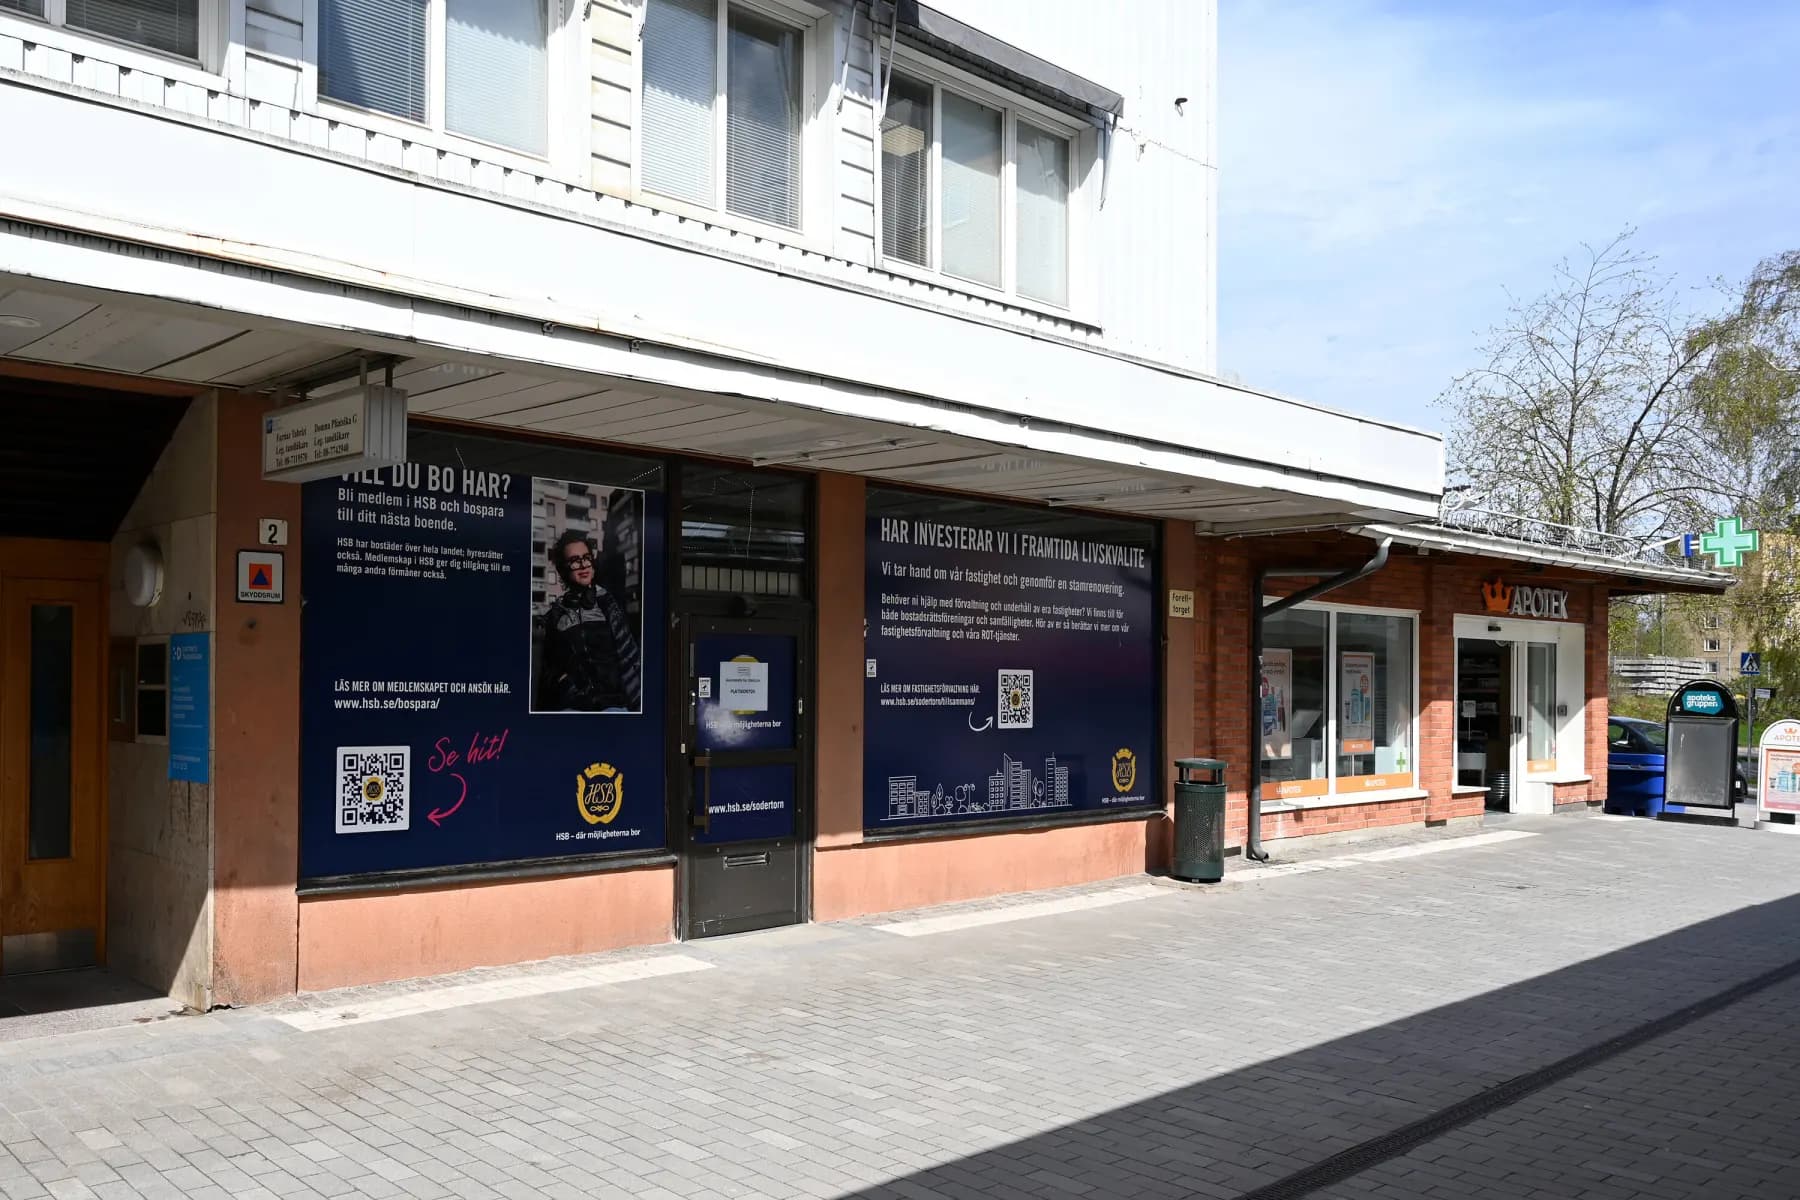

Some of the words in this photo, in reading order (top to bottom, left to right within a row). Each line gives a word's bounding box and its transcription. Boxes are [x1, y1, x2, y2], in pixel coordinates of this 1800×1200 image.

[392, 462, 420, 489] DU
[428, 465, 455, 493] BO
[337, 488, 354, 502] Bli
[357, 491, 403, 507] medlem
[406, 494, 410, 508] i
[414, 496, 437, 511] HSB
[440, 499, 460, 513] och
[463, 501, 504, 519] bospara
[337, 507, 354, 522] till
[357, 510, 377, 524] ditt
[380, 512, 411, 527] nästa
[414, 514, 457, 531] boende.
[267, 523, 278, 544] 2
[914, 520, 993, 553] INVESTERAR
[997, 531, 1009, 554] VI
[1013, 533, 1017, 555] I
[1021, 534, 1079, 562] FRAMTIDA
[337, 537, 354, 547] HSB
[355, 538, 369, 549] har
[370, 539, 403, 551] bostäder
[405, 543, 421, 553] över
[423, 544, 439, 554] hela
[466, 548, 503, 560] hyresrätter
[337, 550, 362, 562] också.
[365, 552, 412, 566] Medlemskap
[419, 556, 434, 566] HSB
[436, 558, 448, 569] ger
[450, 558, 461, 569] dig
[462, 559, 489, 571] tillgång
[491, 561, 501, 571] till
[336, 563, 362, 575] många
[364, 566, 386, 575] andra
[388, 566, 421, 577] förmåner
[423, 569, 447, 580] också.
[881, 561, 891, 576] Vi
[893, 563, 906, 577] tar
[909, 563, 931, 579] hand
[933, 568, 947, 580] om
[949, 566, 963, 581] vår
[965, 568, 1002, 587] fastighet
[1003, 573, 1018, 586] och
[1020, 575, 1056, 590] genomför
[1057, 578, 1067, 590] en
[1069, 579, 1125, 598] stamrenovering.
[240, 591, 281, 599] SKYDDSRUM
[1510, 584, 1569, 619] APOTEK
[881, 593, 910, 606] Behöver
[911, 595, 919, 606] ni
[920, 594, 938, 609] hjälp
[939, 597, 953, 608] med
[955, 598, 989, 612] förvaltning
[990, 600, 1001, 611] och
[1003, 602, 1032, 613] underhåll
[1032, 605, 1041, 614] av
[1041, 606, 1051, 615] era
[1087, 607, 1093, 617] Vi
[1093, 608, 1106, 619] finns
[1107, 608, 1115, 619] till
[881, 608, 899, 621] både
[901, 610, 974, 626] bostadsrättsföreningar
[976, 614, 988, 625] och
[1035, 618, 1046, 629] Hör
[1047, 620, 1055, 629] av
[1063, 619, 1070, 630] så
[1071, 620, 1093, 630] berättar
[881, 625, 951, 640] fastighetsförvaltning
[952, 629, 964, 640] och
[965, 628, 980, 640] våra
[334, 678, 351, 692] LÄS
[352, 680, 371, 692] MER
[372, 681, 386, 692] OM
[387, 681, 448, 693] MEDLEMSKAPET
[450, 682, 467, 693] OCH
[468, 681, 492, 694] ANSÖK
[493, 681, 511, 694] HÄR.
[880, 682, 890, 693] LÄS
[890, 683, 902, 693] MER
[902, 684, 911, 693] OM
[911, 683, 969, 694] FASTIGHETSFÖRVALTNING
[334, 698, 441, 712] www.hsb.se/bospara/
[1686, 693, 1717, 702] apoteks
[1686, 700, 1719, 709] gruppen
[735, 719, 772, 730] möjligheterna
[772, 719, 782, 727] bor
[427, 736, 460, 772] Se
[467, 728, 510, 764] hit!
[584, 781, 615, 804] HSB
[708, 800, 785, 815] www.hsb.se/sodertorn
[555, 832, 570, 841] HSB
[575, 831, 586, 840] där
[587, 829, 629, 840] möjligheterna
[630, 828, 641, 836] bor
